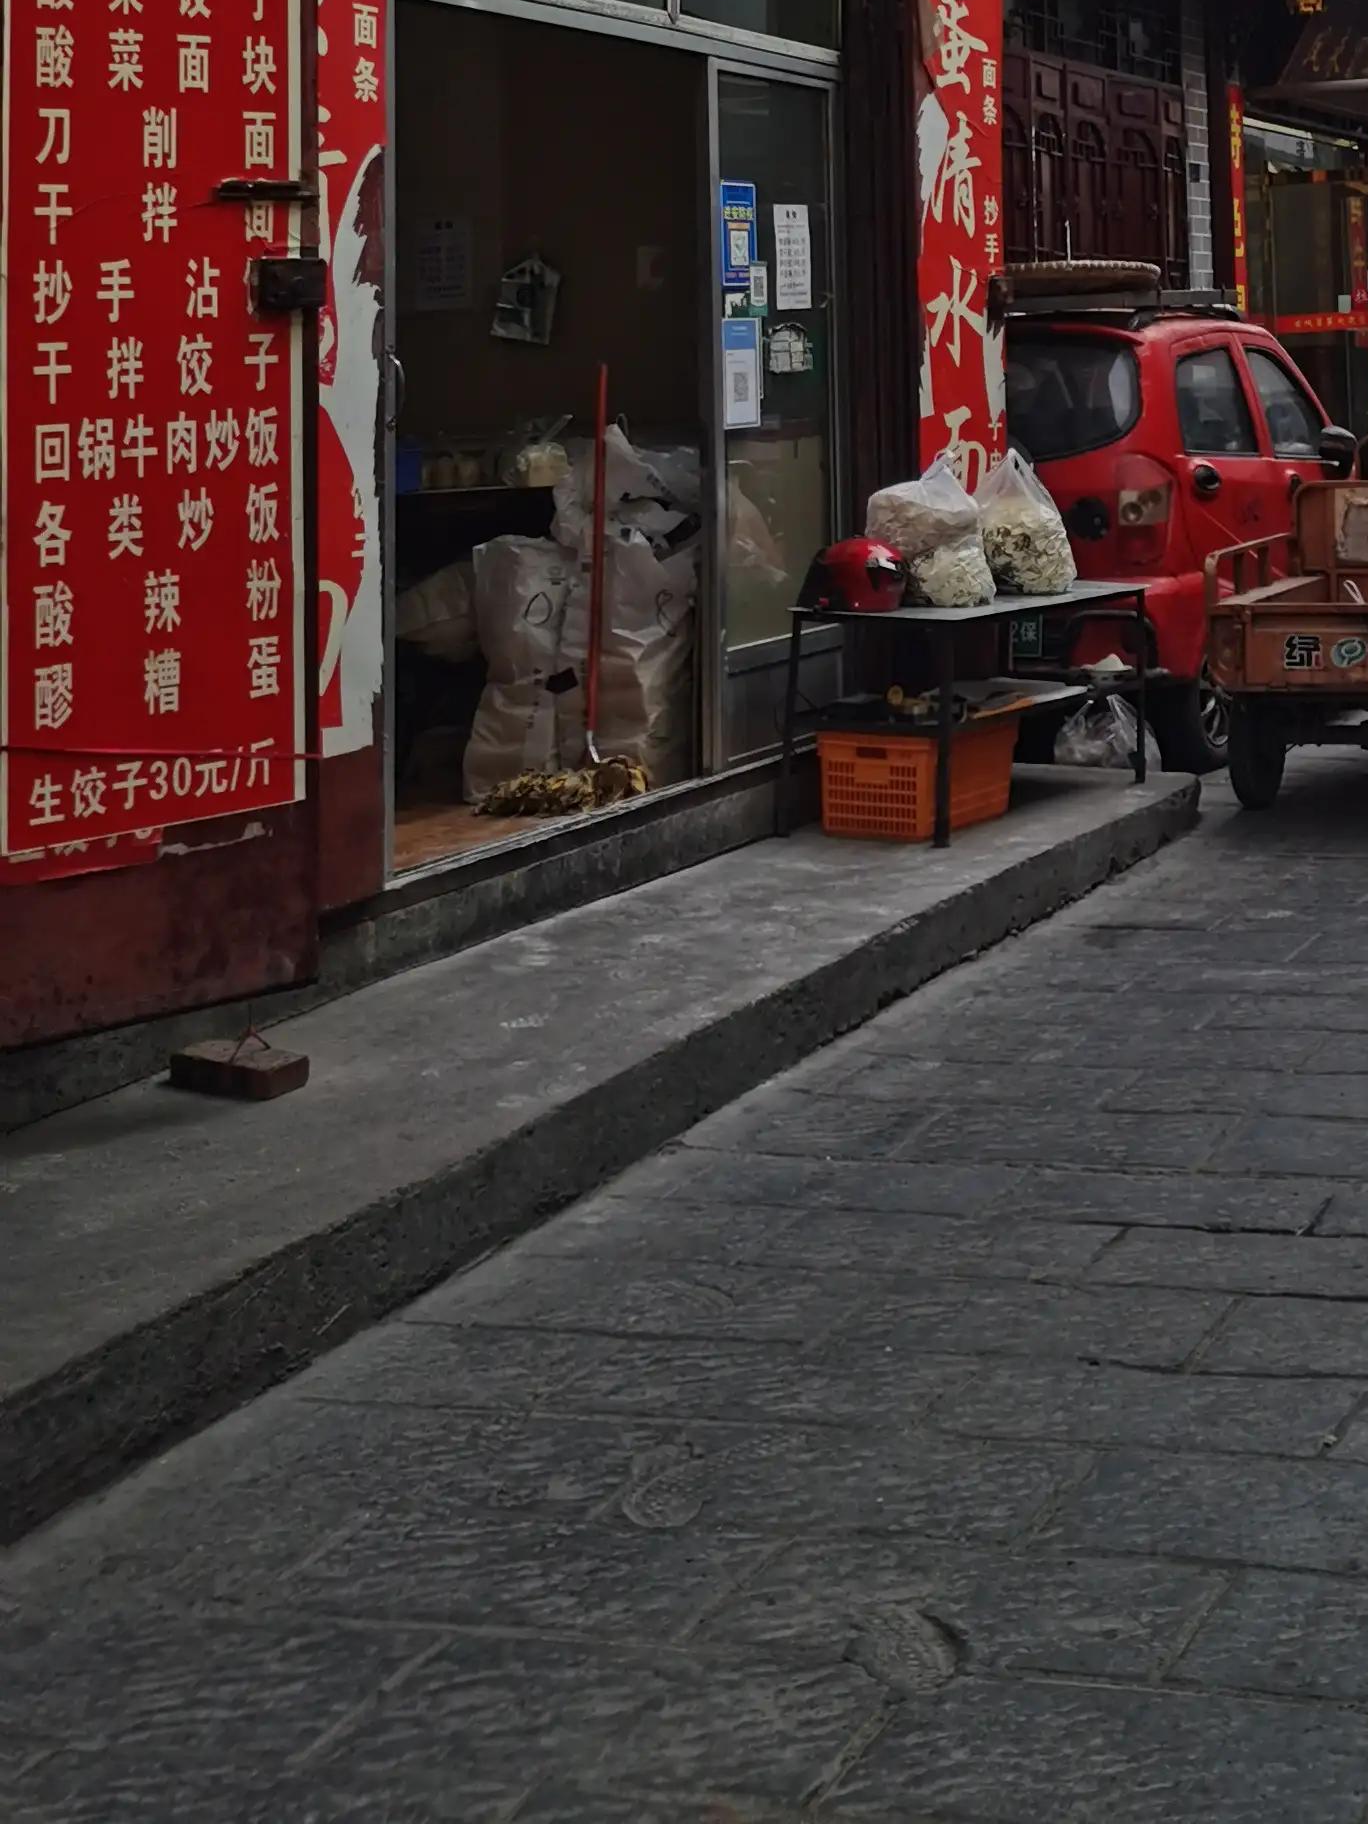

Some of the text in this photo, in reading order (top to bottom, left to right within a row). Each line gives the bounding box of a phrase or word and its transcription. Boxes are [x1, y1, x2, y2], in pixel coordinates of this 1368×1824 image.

[35, 24, 277, 95] 酸菜面块
[352, 3, 379, 103] 面条
[35, 105, 277, 170] 刀削面
[33, 181, 275, 245] 干拌面
[32, 256, 252, 325] 抄手沾
[32, 333, 279, 405] 干拌饺子
[35, 406, 279, 484] 回锅牛肉炒饭
[32, 482, 280, 568] 各类炒饭
[32, 557, 282, 650] 酸辣粉
[34, 635, 281, 731] 醪糟蛋
[29, 737, 275, 827] 生饺子30元/斤
